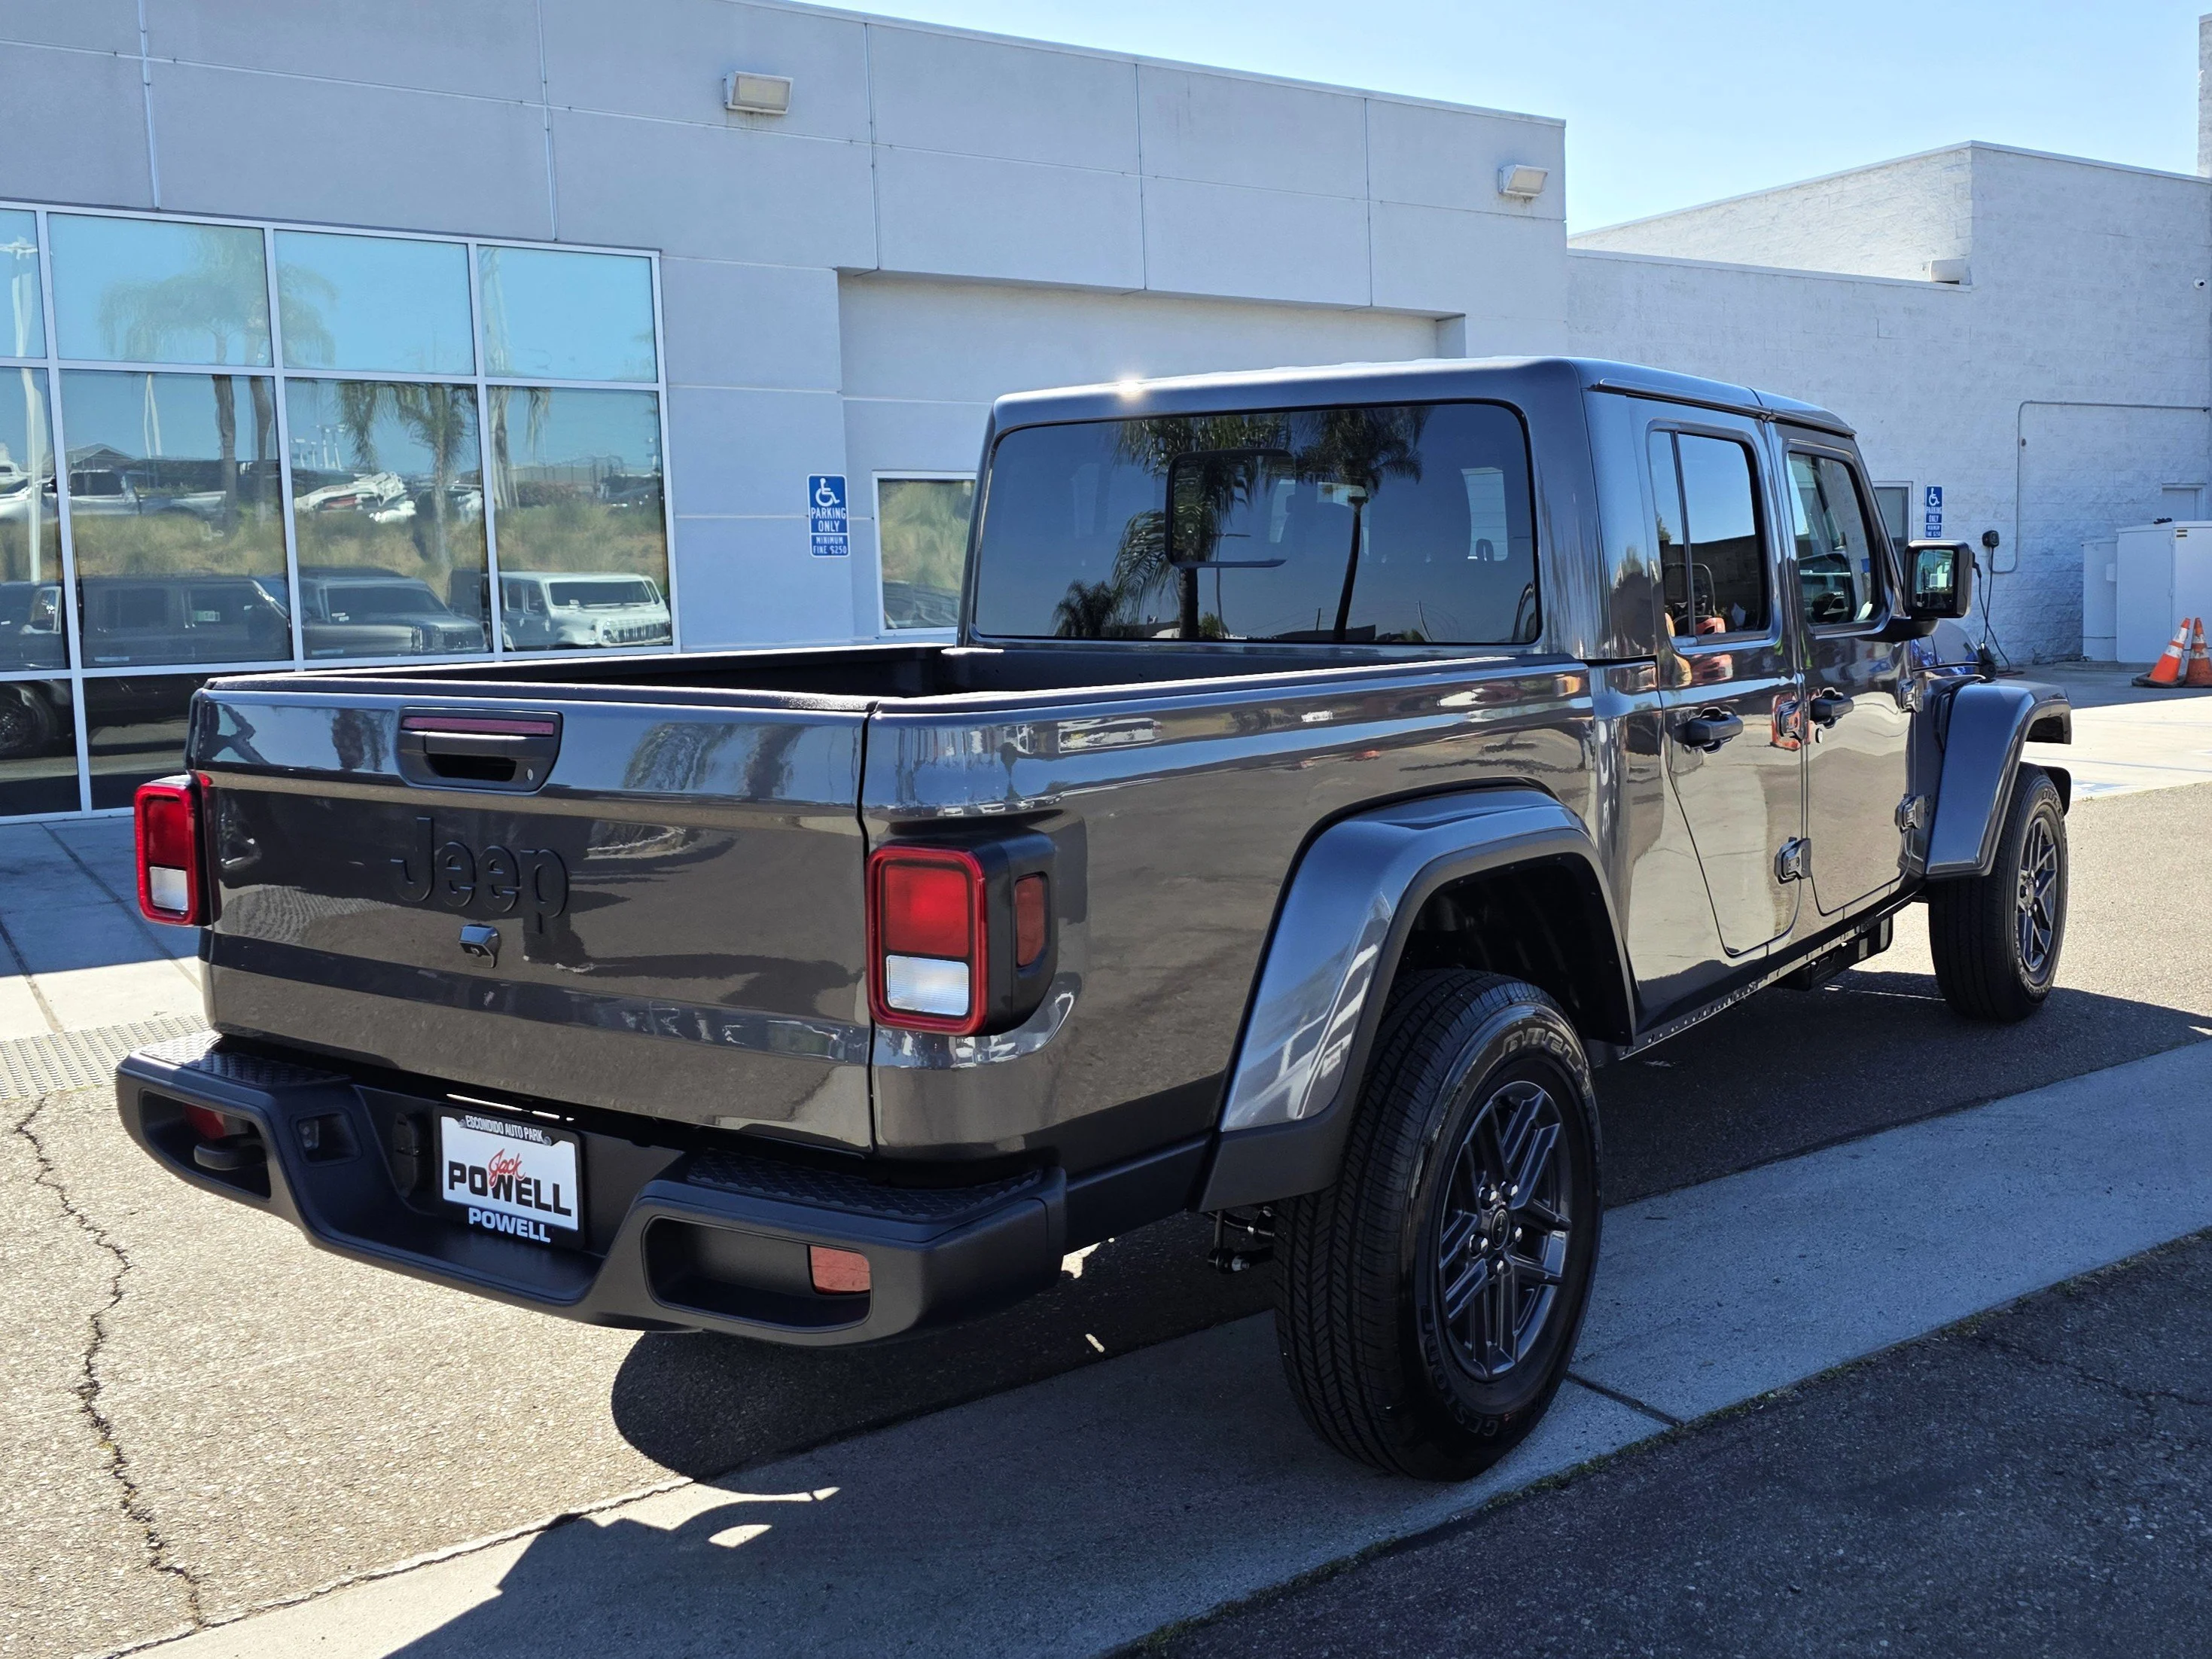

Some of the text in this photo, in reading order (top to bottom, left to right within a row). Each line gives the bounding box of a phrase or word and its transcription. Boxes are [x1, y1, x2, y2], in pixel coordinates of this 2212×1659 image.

[811, 507, 846, 520] PARKING
[818, 520, 840, 532] ONLY
[813, 545, 847, 555] FINE $250
[815, 536, 843, 544] MINIMUM
[390, 816, 569, 934] Jeep
[465, 1115, 544, 1143] ESCONDIDO AUTO PARK
[488, 1148, 526, 1188] Jack
[448, 1160, 572, 1217] POWELL
[468, 1207, 551, 1243] POWELL
